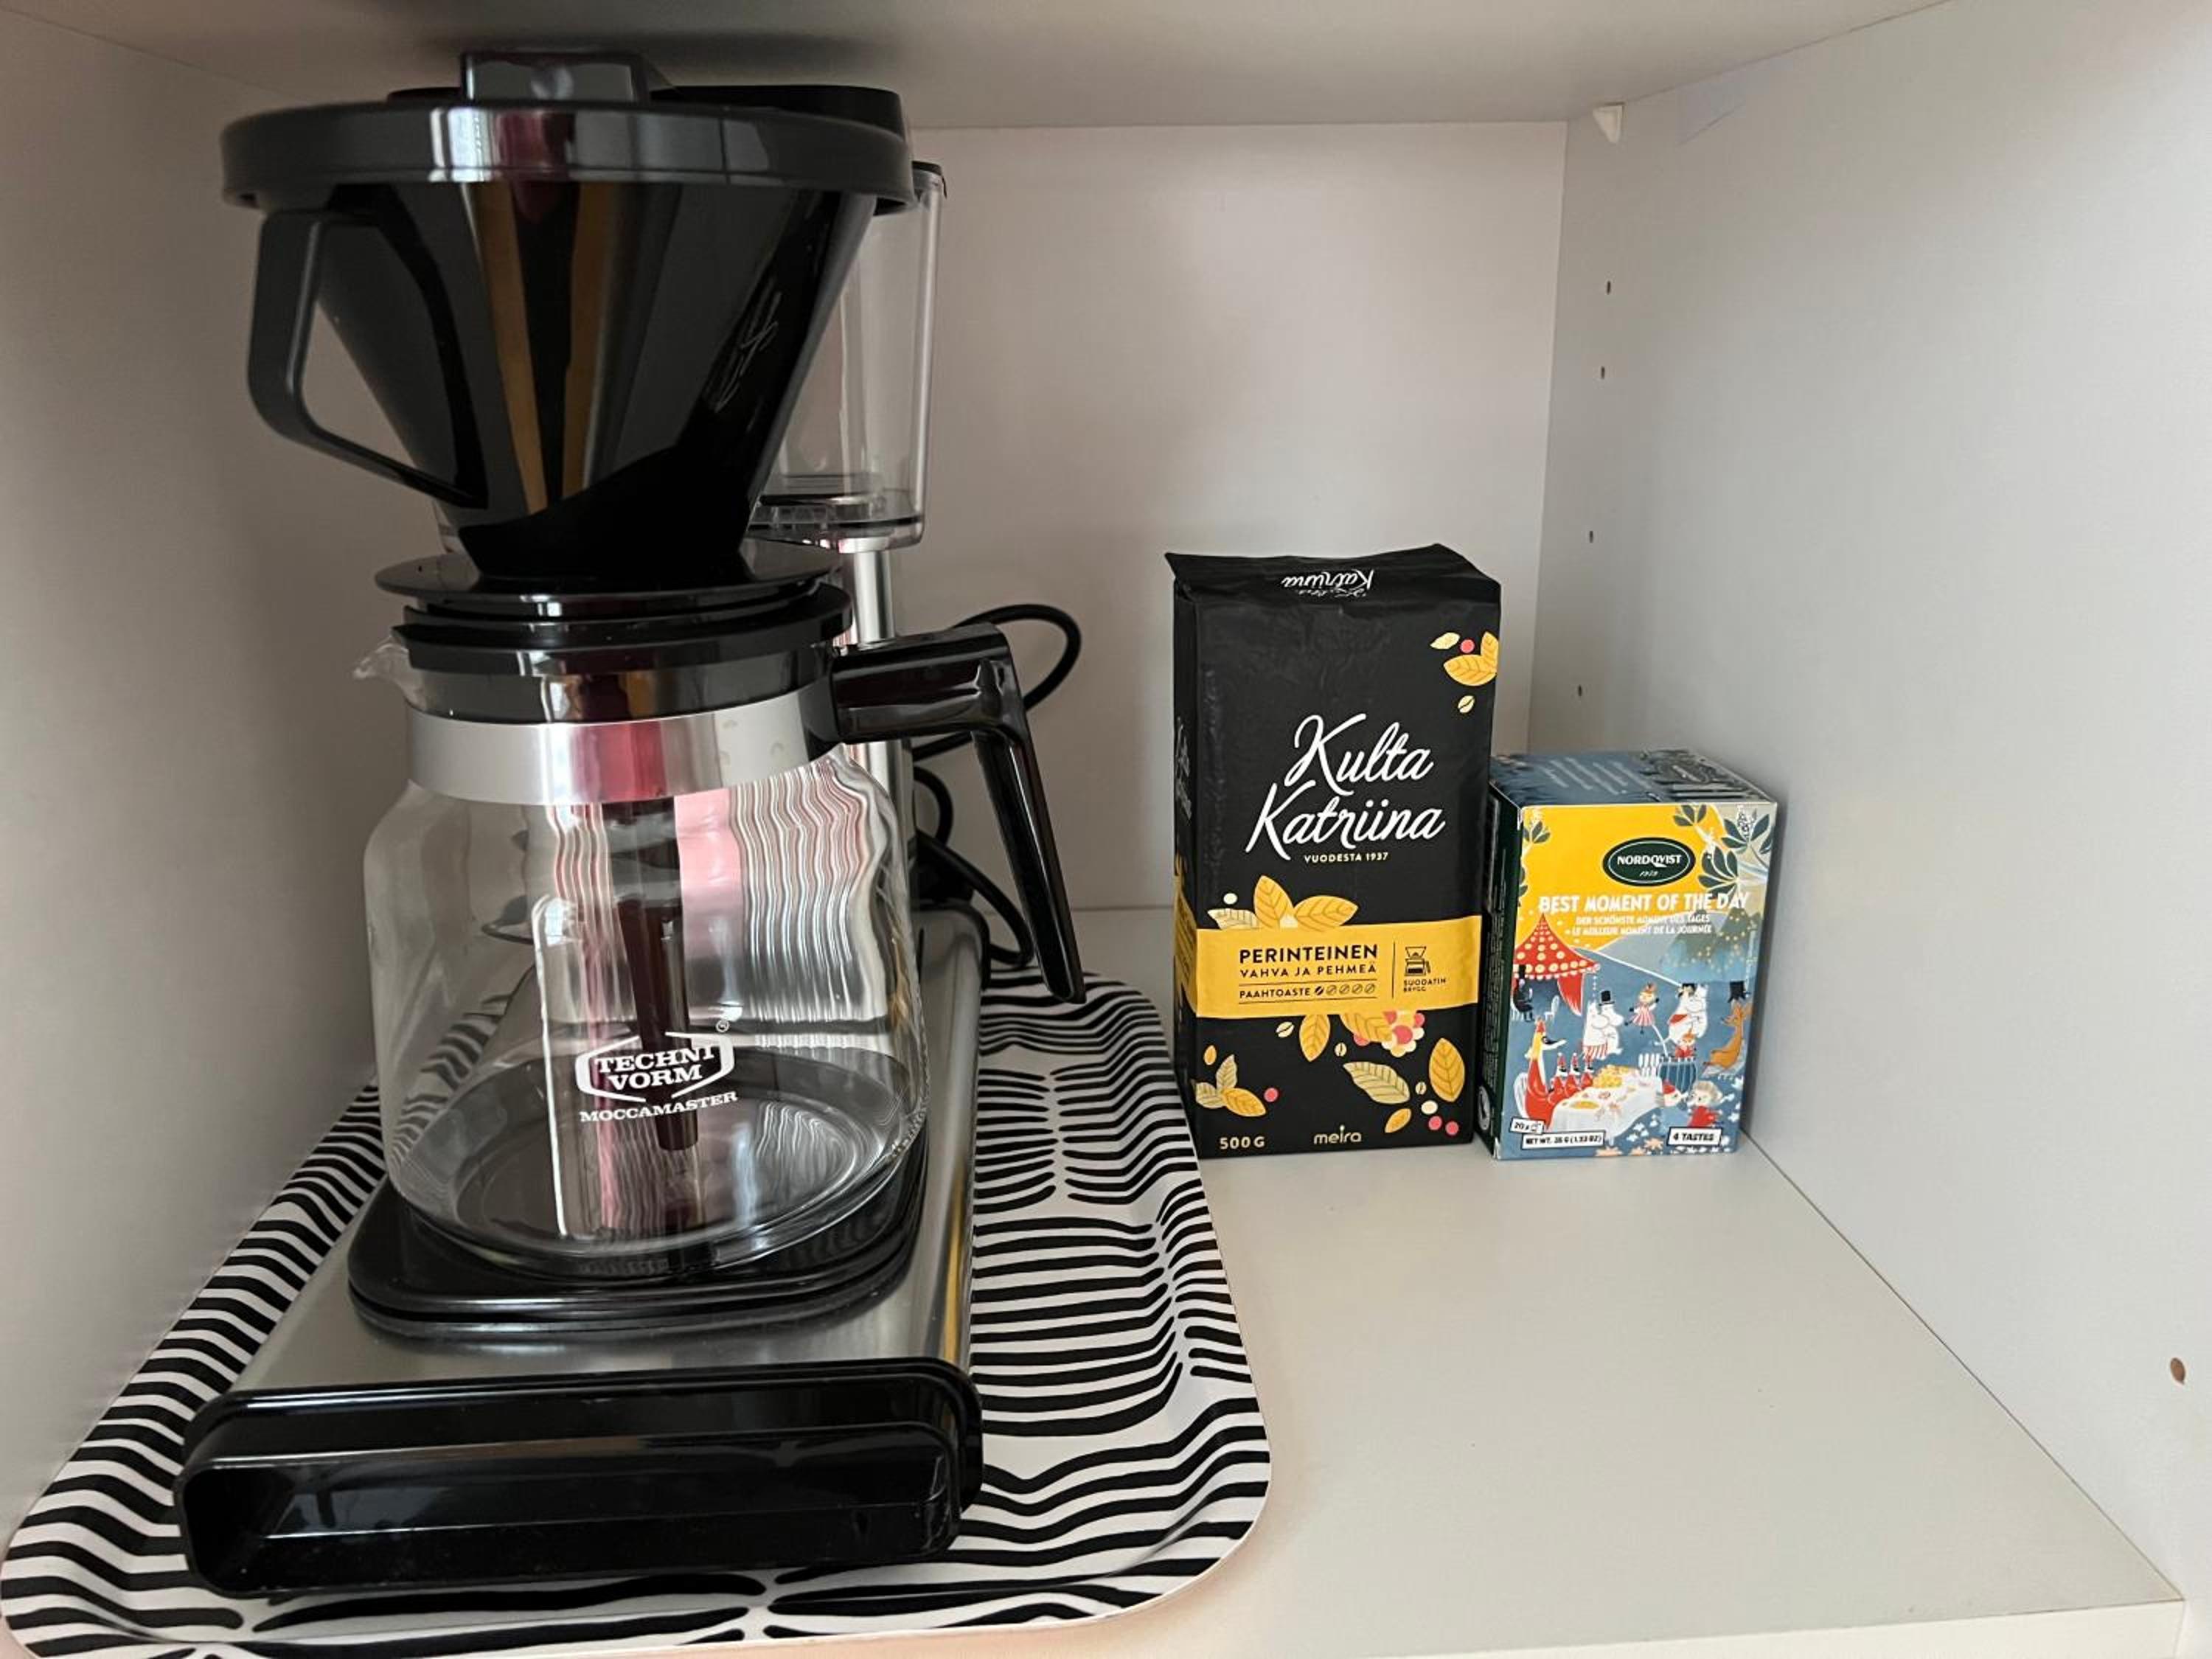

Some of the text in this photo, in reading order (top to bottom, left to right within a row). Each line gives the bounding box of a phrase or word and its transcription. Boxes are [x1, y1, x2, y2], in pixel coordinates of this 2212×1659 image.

[1284, 713, 1435, 796] Kulta
[1245, 780, 1446, 860] Katriina
[1304, 852, 1388, 864] VUODESTA 1937
[1617, 855, 1682, 868] NORDQVIST
[1538, 892, 1749, 913] BEST MOMENT OF THE DAY
[1687, 914, 1711, 923] TAGES
[1239, 945, 1378, 964] PERINTEINEN
[1240, 961, 1377, 978] VAHVA JA PEHMEÄ
[1239, 987, 1310, 999] PAAHTOASTE
[595, 1044, 715, 1074] TECHNI
[608, 1065, 703, 1091] VORM
[580, 1091, 738, 1122] MOCCAMASTER
[1220, 1135, 1265, 1150] 500 G
[1313, 1124, 1363, 1144] meira
[1682, 1132, 1714, 1140] TASTES
